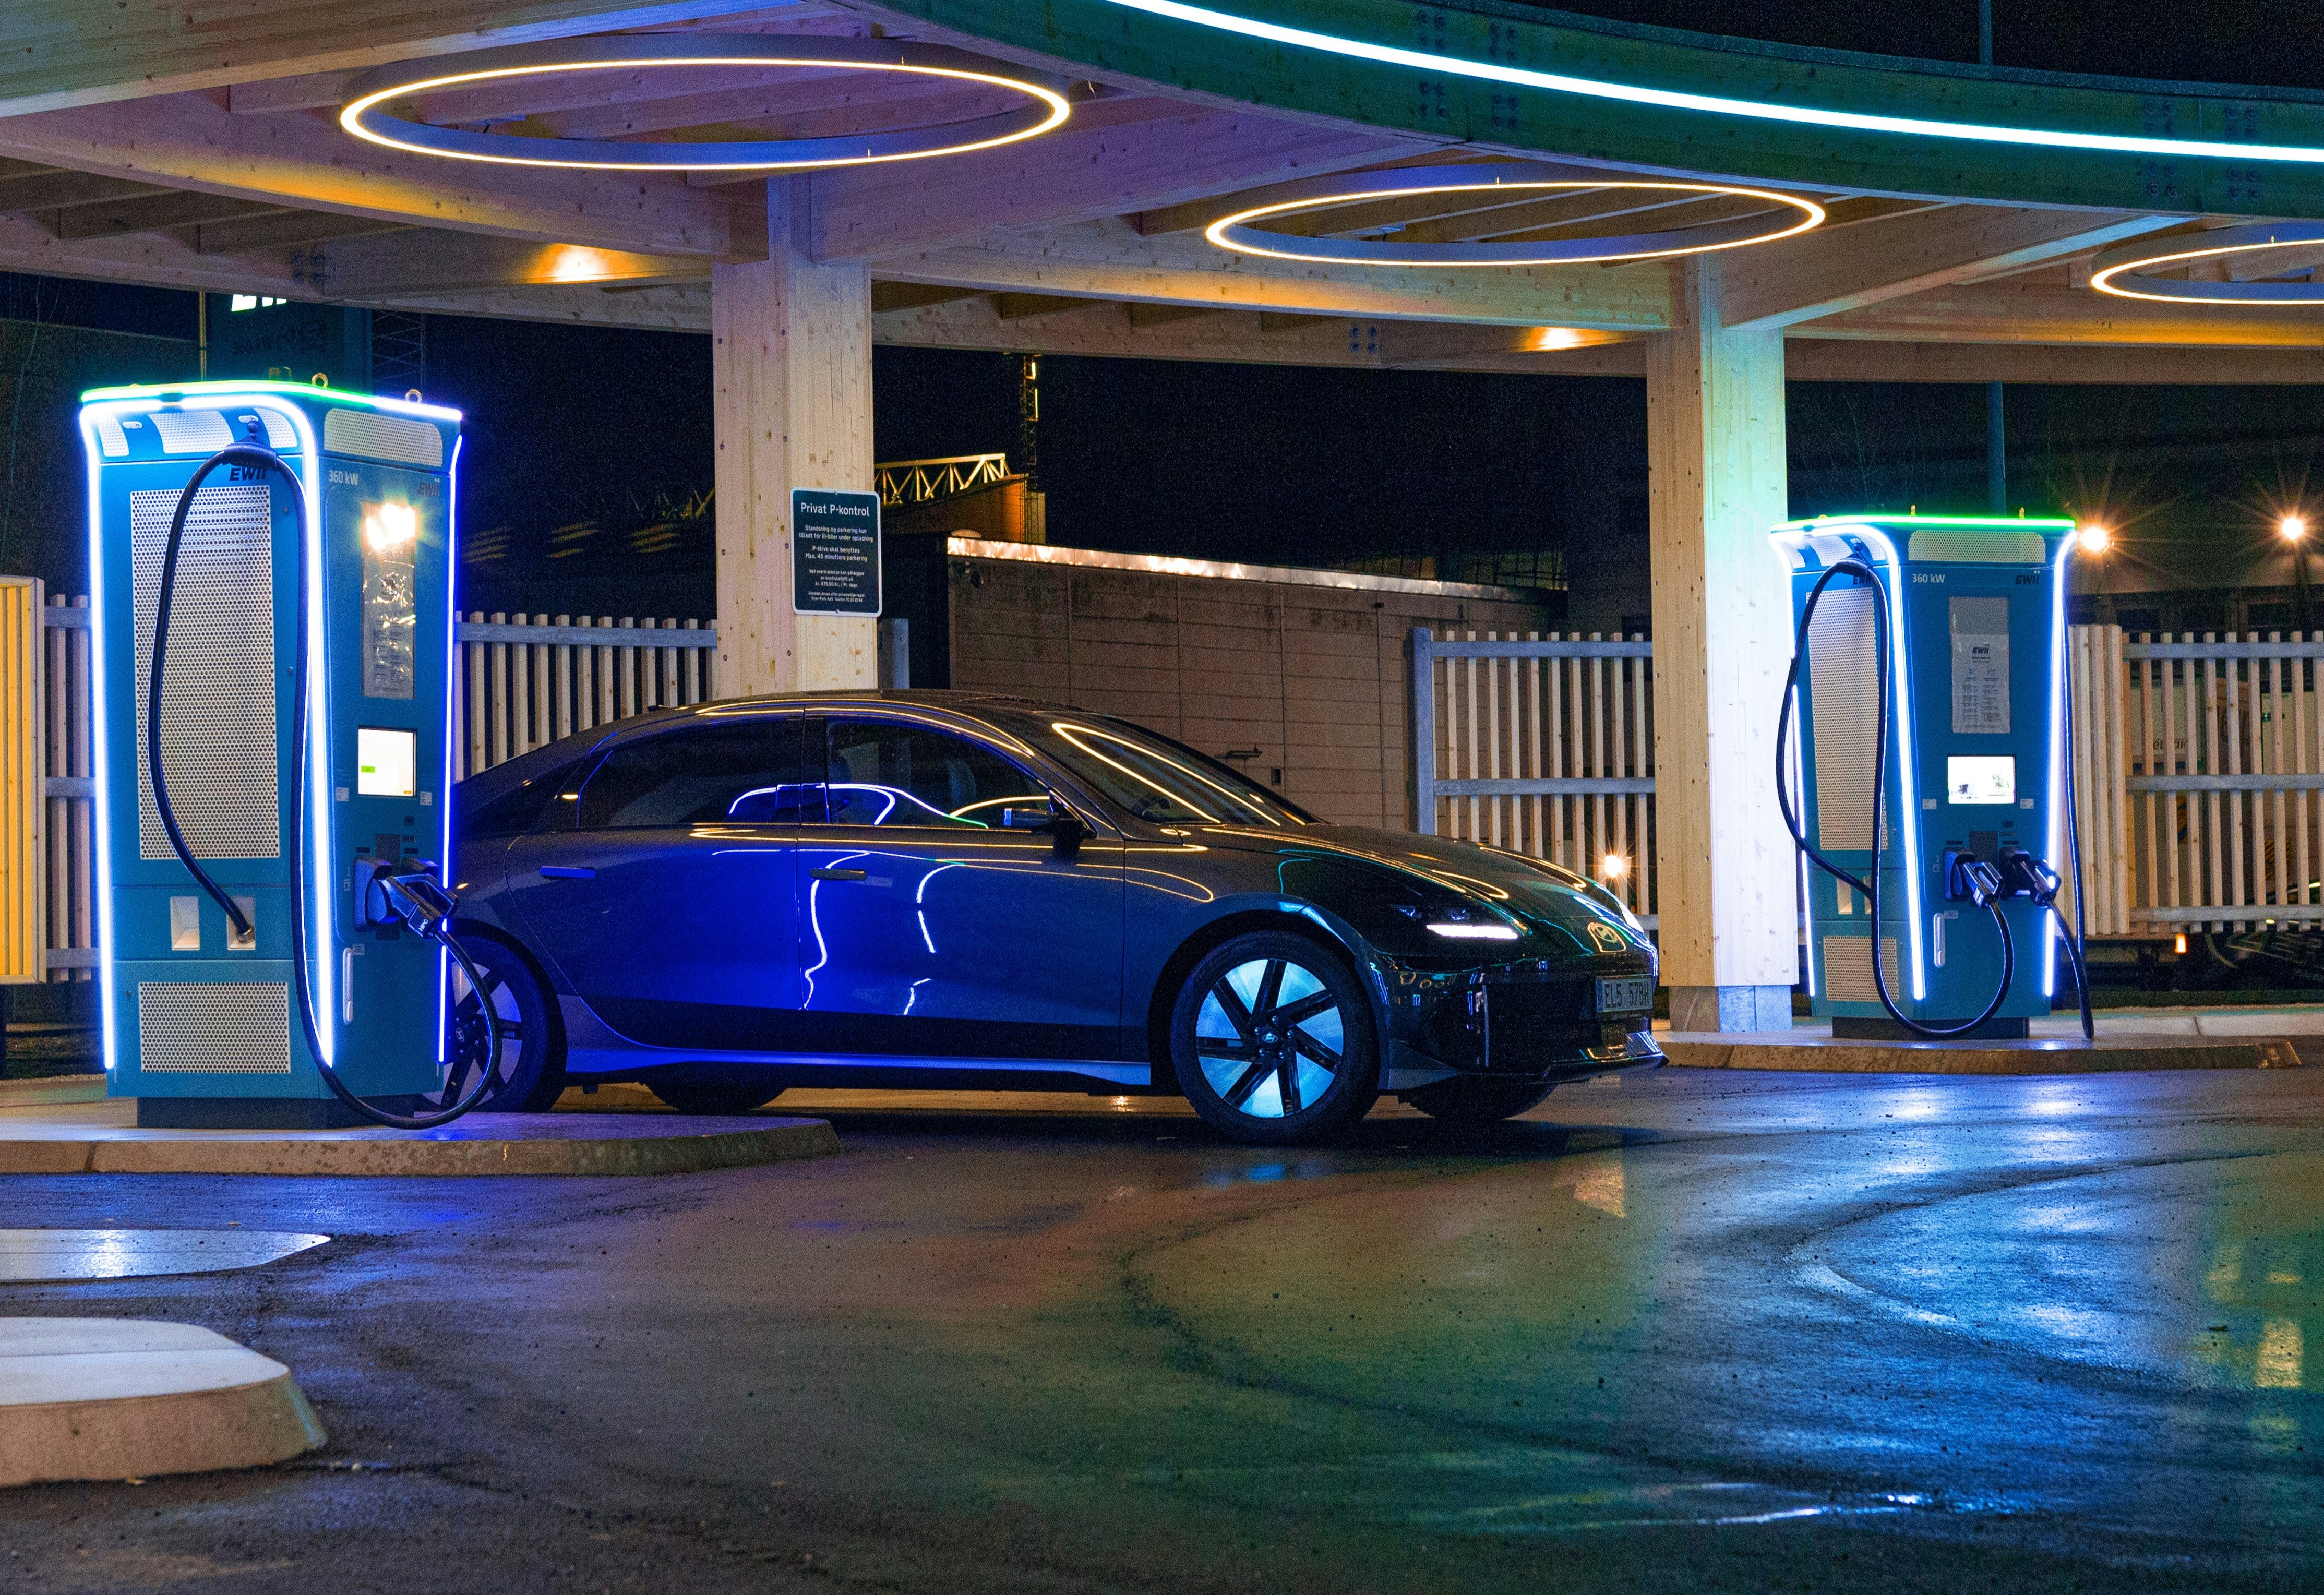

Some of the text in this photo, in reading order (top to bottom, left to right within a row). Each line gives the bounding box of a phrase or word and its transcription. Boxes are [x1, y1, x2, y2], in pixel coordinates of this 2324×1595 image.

[329, 470, 358, 486] 360 kW
[801, 502, 870, 517] Privat P-kontrol
[1912, 573, 1945, 583] 360 kW
[418, 918, 429, 932] HPC
